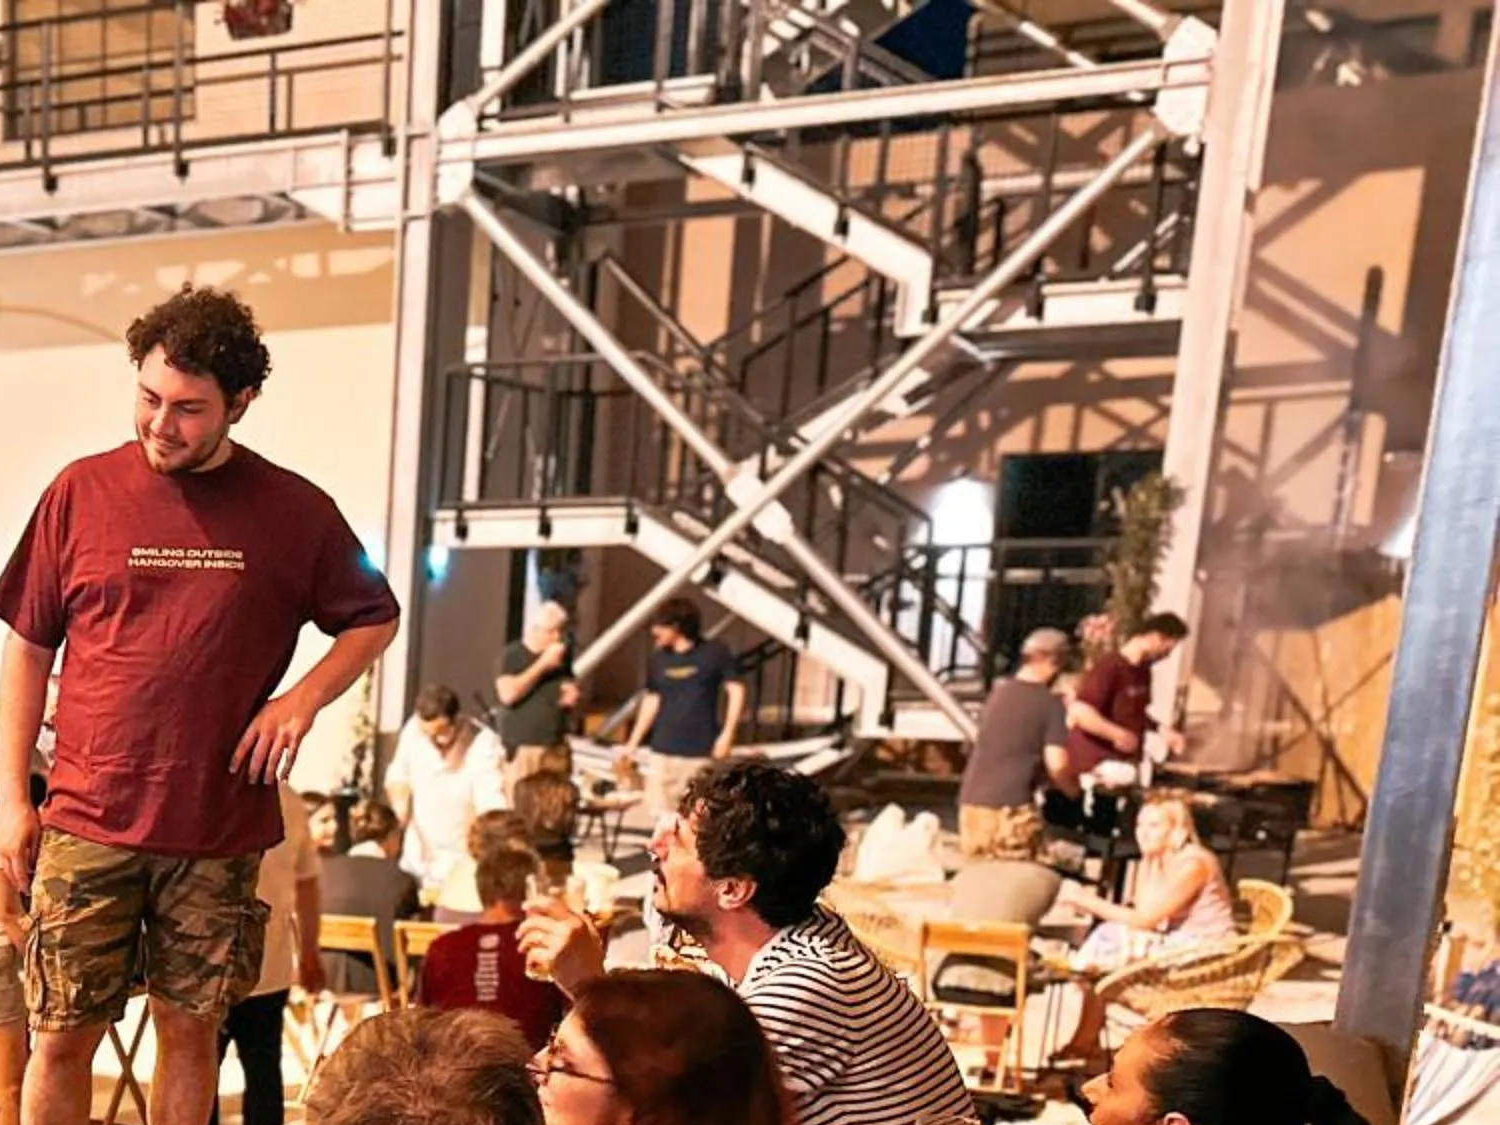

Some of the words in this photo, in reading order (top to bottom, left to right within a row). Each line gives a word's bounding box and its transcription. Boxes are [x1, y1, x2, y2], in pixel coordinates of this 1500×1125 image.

[131, 547, 185, 557] SMILING
[187, 548, 243, 559] OUTSIDE
[127, 557, 202, 569] HANGOVER
[203, 559, 245, 571] INSIDE
